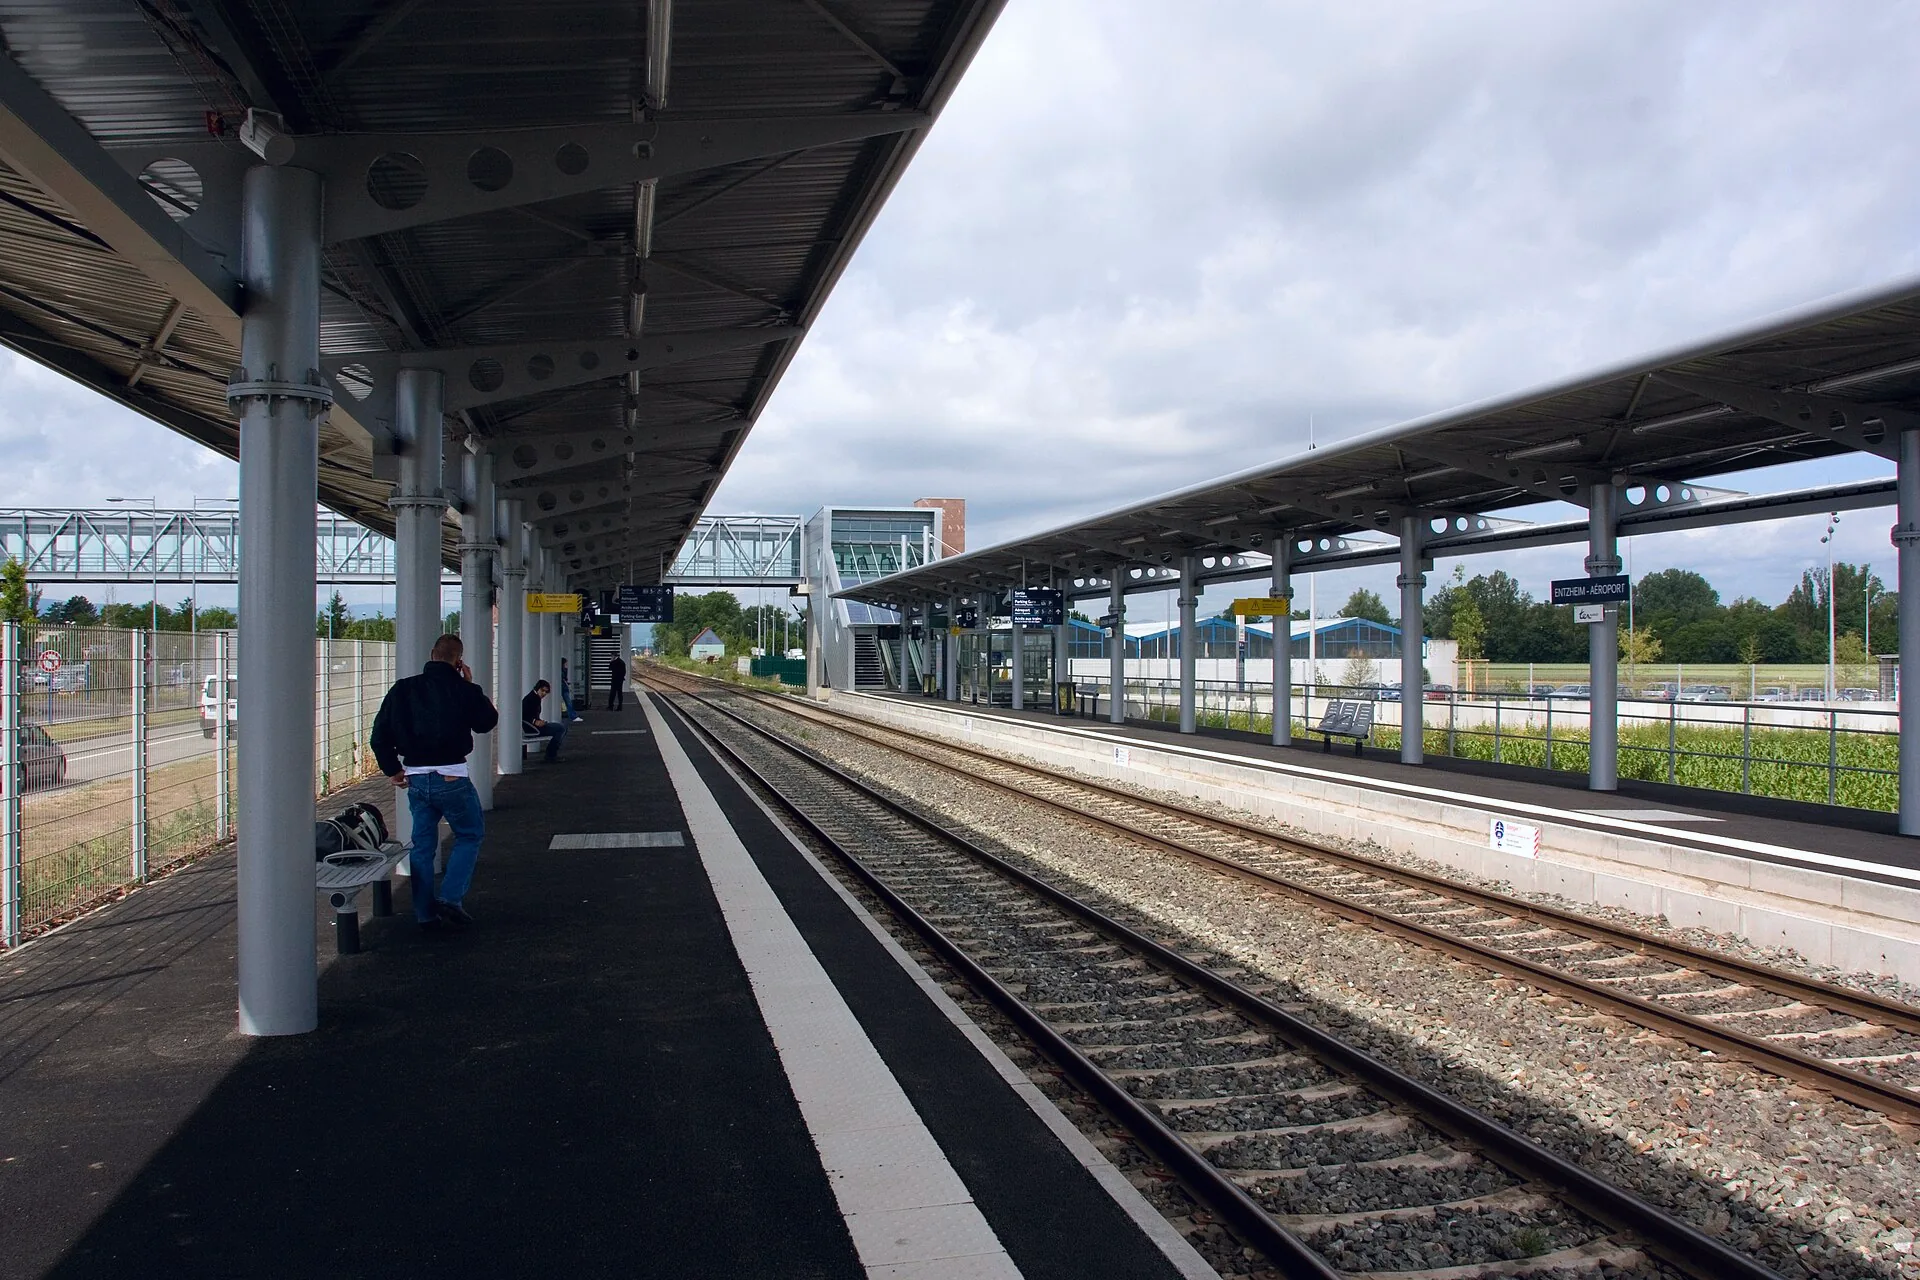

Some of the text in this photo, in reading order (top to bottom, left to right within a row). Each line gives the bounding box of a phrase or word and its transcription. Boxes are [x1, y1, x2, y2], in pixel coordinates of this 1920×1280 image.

[1554, 586, 1586, 598] ENTZHEIM
[1590, 583, 1625, 595] AÉROPORT
[583, 612, 591, 622] A
[965, 612, 973, 621] B
